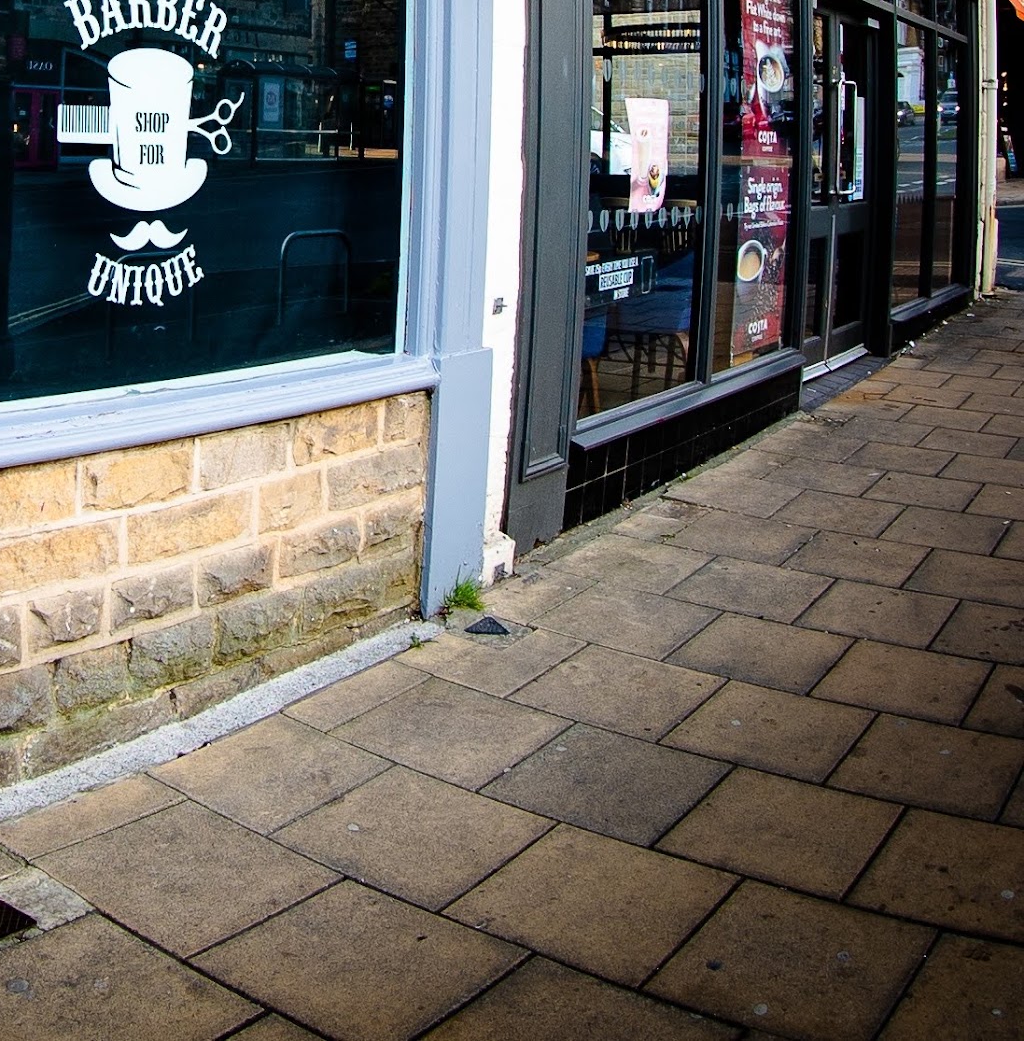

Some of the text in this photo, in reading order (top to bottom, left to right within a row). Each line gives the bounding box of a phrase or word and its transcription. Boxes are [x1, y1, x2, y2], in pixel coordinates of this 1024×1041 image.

[135, 112, 169, 133] SHOP
[758, 130, 778, 145] COSTA
[139, 144, 165, 165] FOR
[743, 196, 759, 220] Bags
[87, 244, 205, 306] UNIQUE
[748, 318, 768, 335] COSTA
